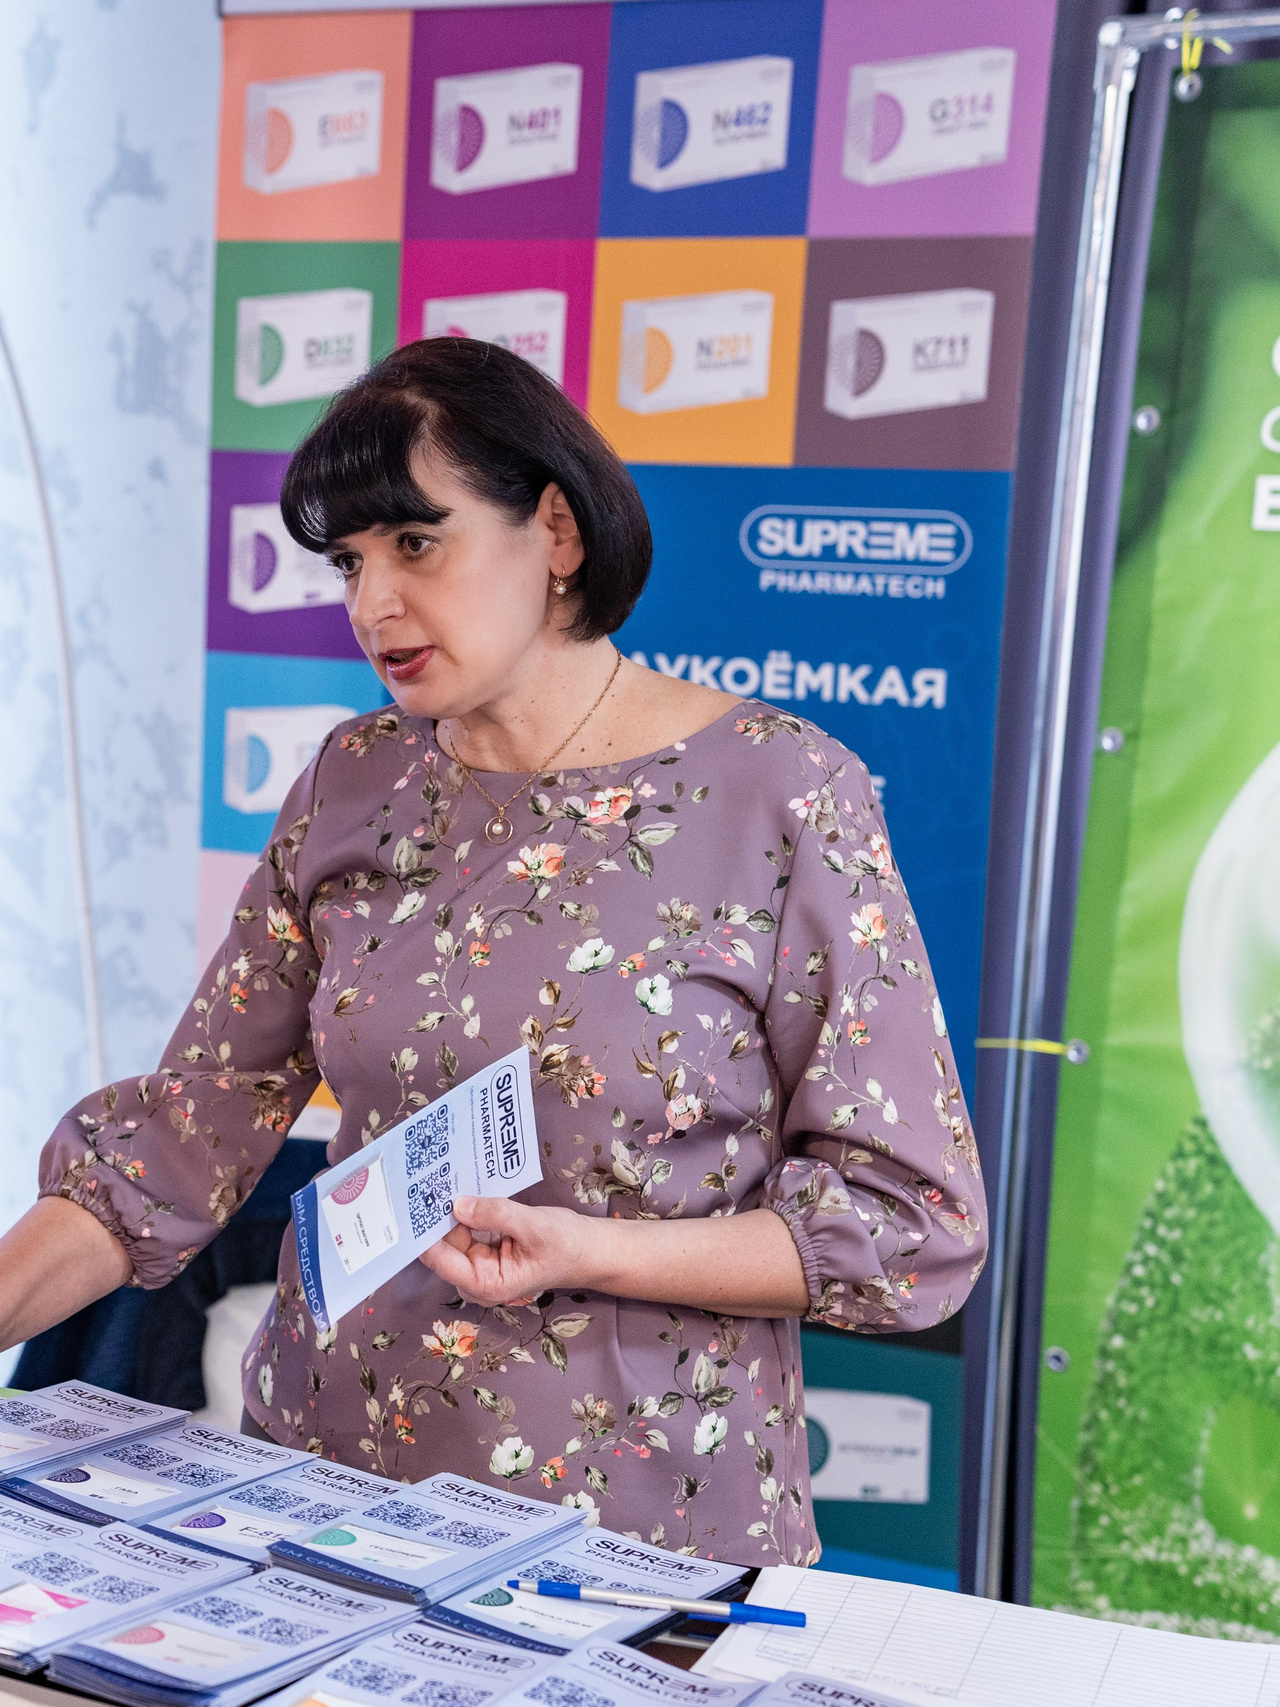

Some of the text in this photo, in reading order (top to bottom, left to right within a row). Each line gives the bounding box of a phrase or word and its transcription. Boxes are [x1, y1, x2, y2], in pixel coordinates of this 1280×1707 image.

[912, 332, 969, 359] K711
[756, 516, 958, 563] SUPREME
[759, 568, 946, 599] PHARMATECH
[480, 1087, 496, 1179] PHARMATECH
[496, 1072, 521, 1174] SUPREME
[298, 1226, 328, 1330] СРЕДСТВОМ
[53, 1393, 135, 1420] PHARMATECH
[66, 1388, 156, 1418] SUPREME
[179, 1435, 265, 1464] PHARMATECH
[190, 1428, 286, 1461] SUPREME
[300, 1474, 383, 1500] PHARMATEC
[311, 1467, 400, 1496] SUPREM
[29, 1490, 113, 1523] СРЕДСТВОМ
[430, 1489, 531, 1521] PHARMATECH
[441, 1482, 550, 1518] SUPREME
[94, 1541, 188, 1575] PHARMATECH
[107, 1532, 212, 1571] SUPREME
[585, 1549, 691, 1581] PHARMATECH
[594, 1540, 711, 1576] SUPREME
[305, 1553, 415, 1594] СРЕДСТВОМ
[254, 1584, 356, 1618] PHARMATECH
[268, 1575, 381, 1614] SUPREME
[392, 1642, 509, 1675] PHARMATECH
[402, 1631, 523, 1669] SUPREME
[597, 1649, 731, 1698] SUPREME
